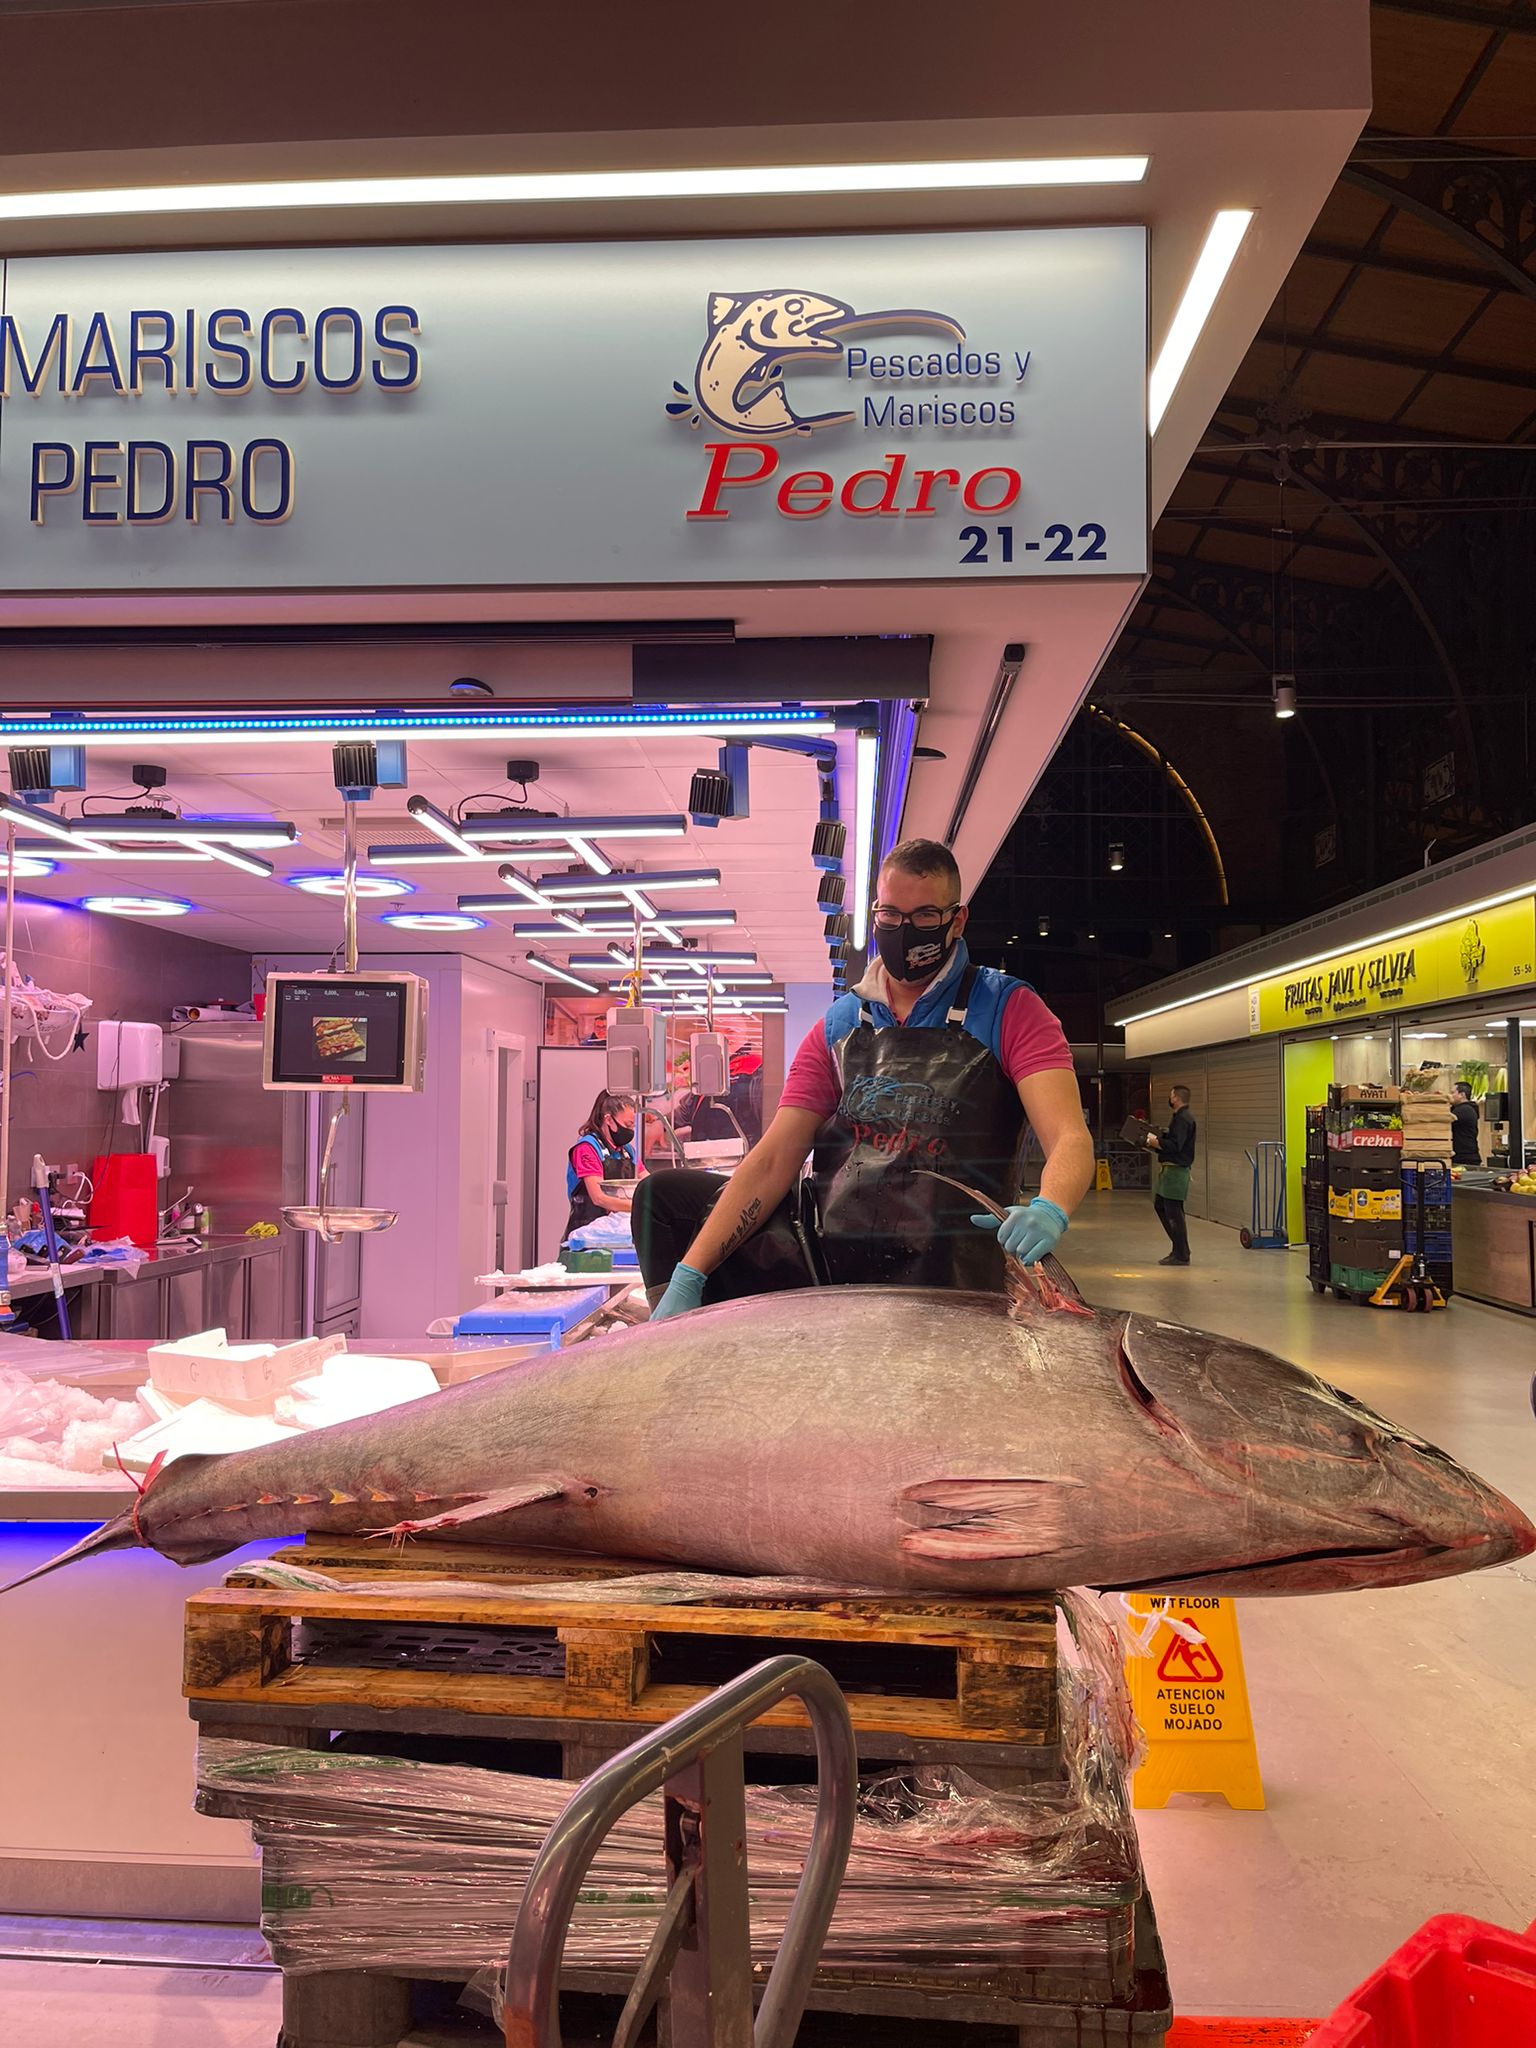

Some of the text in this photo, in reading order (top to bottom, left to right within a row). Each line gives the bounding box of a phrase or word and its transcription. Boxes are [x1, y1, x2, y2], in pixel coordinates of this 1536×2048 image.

[0, 305, 421, 398] MARISCOS
[847, 344, 1032, 382] Pescados y
[863, 394, 1016, 430] Mariscos
[30, 438, 295, 525] PEDRO
[685, 443, 1022, 521] Pedro
[958, 522, 1108, 564] 21-22
[1284, 975, 1323, 1012] FRUTAS
[1325, 965, 1355, 1004] JAVI
[1357, 962, 1366, 990] Y
[1367, 948, 1416, 989] SILVIA
[1360, 1089, 1388, 1099] AYATI
[853, 1123, 946, 1155] Pedro
[1179, 1597, 1220, 1609] FLOOR
[1156, 1688, 1225, 1700] ATENCION
[1169, 1703, 1215, 1715] SUELO
[1164, 1718, 1223, 1730] MOJADO
